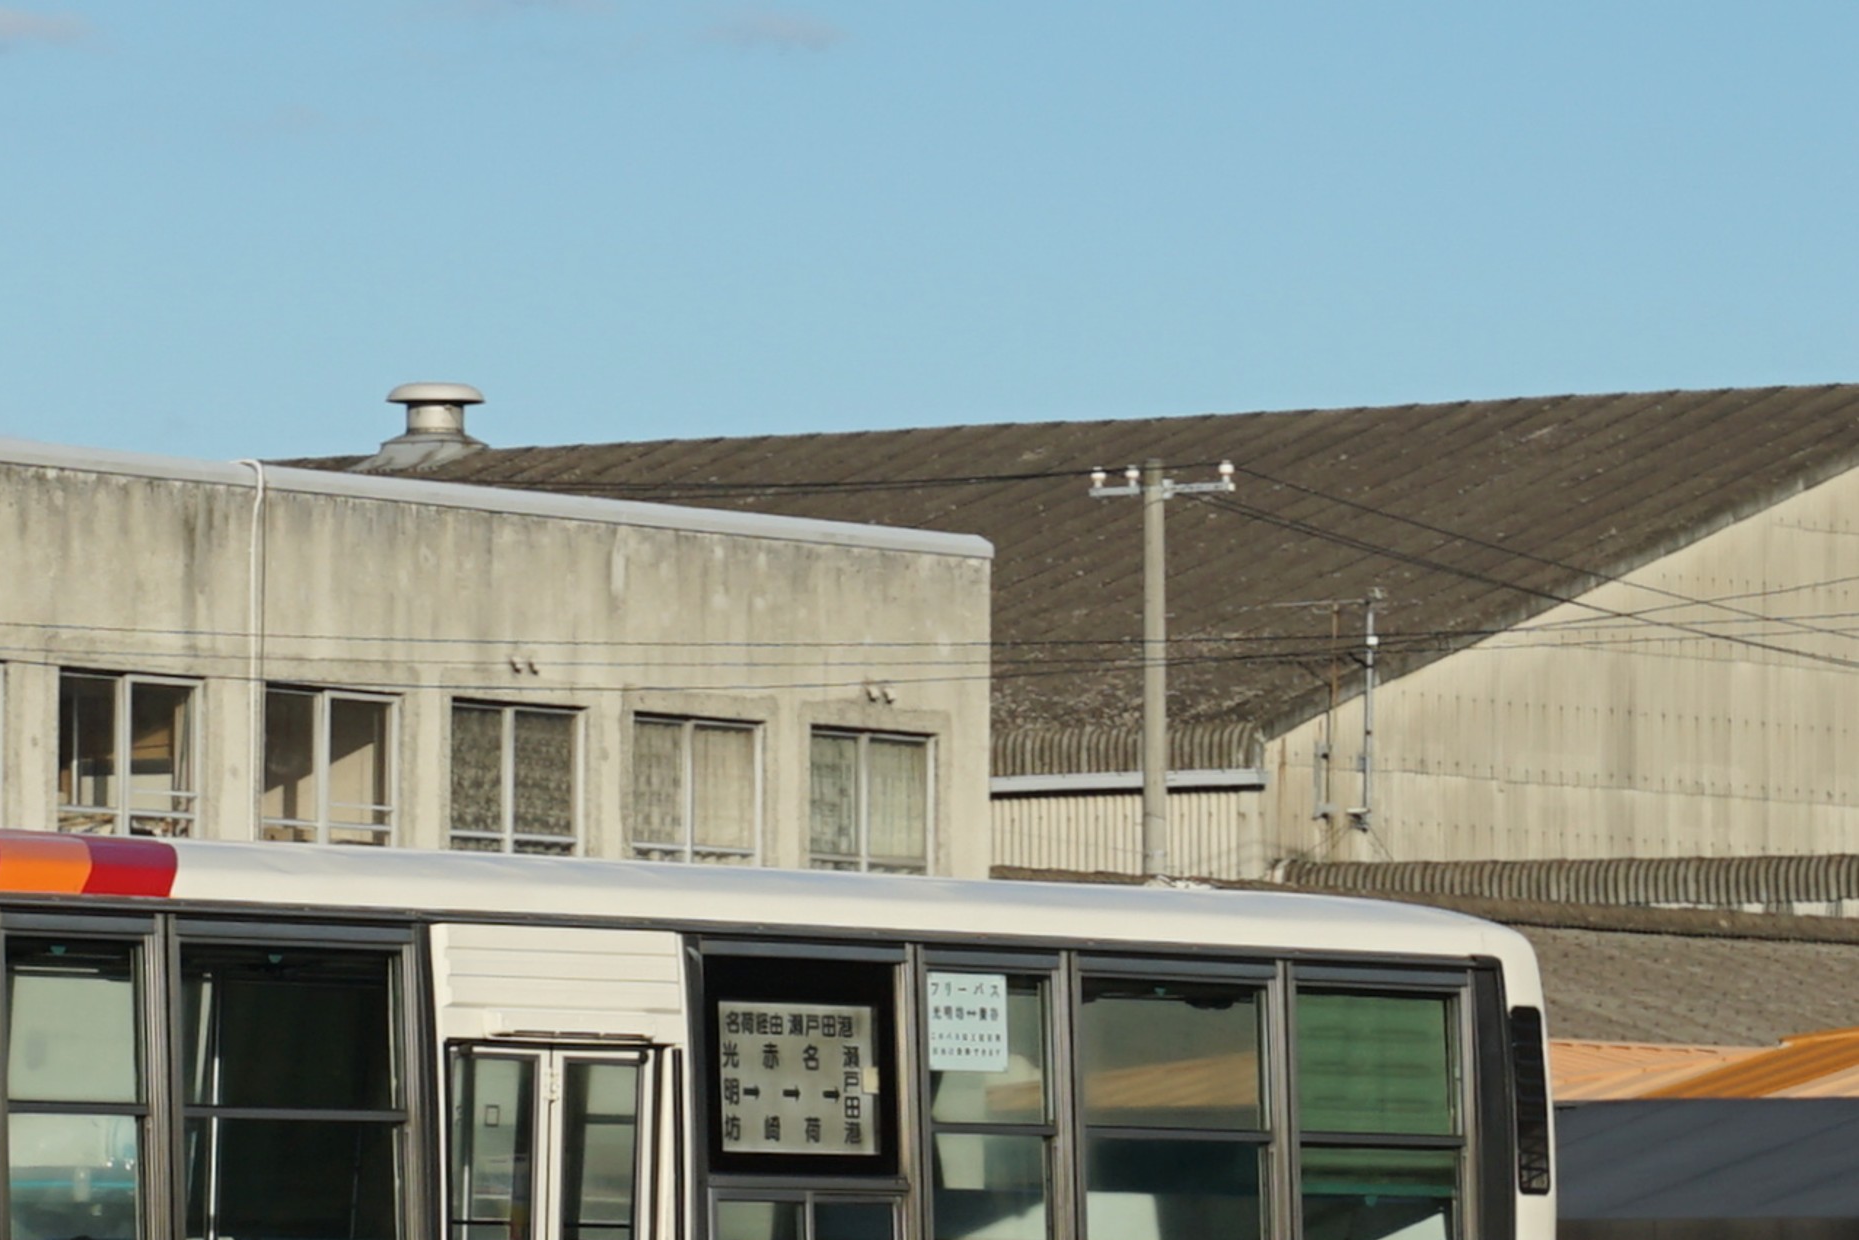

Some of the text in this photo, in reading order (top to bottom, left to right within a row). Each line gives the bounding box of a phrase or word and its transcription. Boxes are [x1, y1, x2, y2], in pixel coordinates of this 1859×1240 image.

[931, 982, 999, 998] フリーバス
[725, 1011, 853, 1038] 名荷経由 瀬戸田港
[842, 1045, 861, 1145] 瀬戸田港
